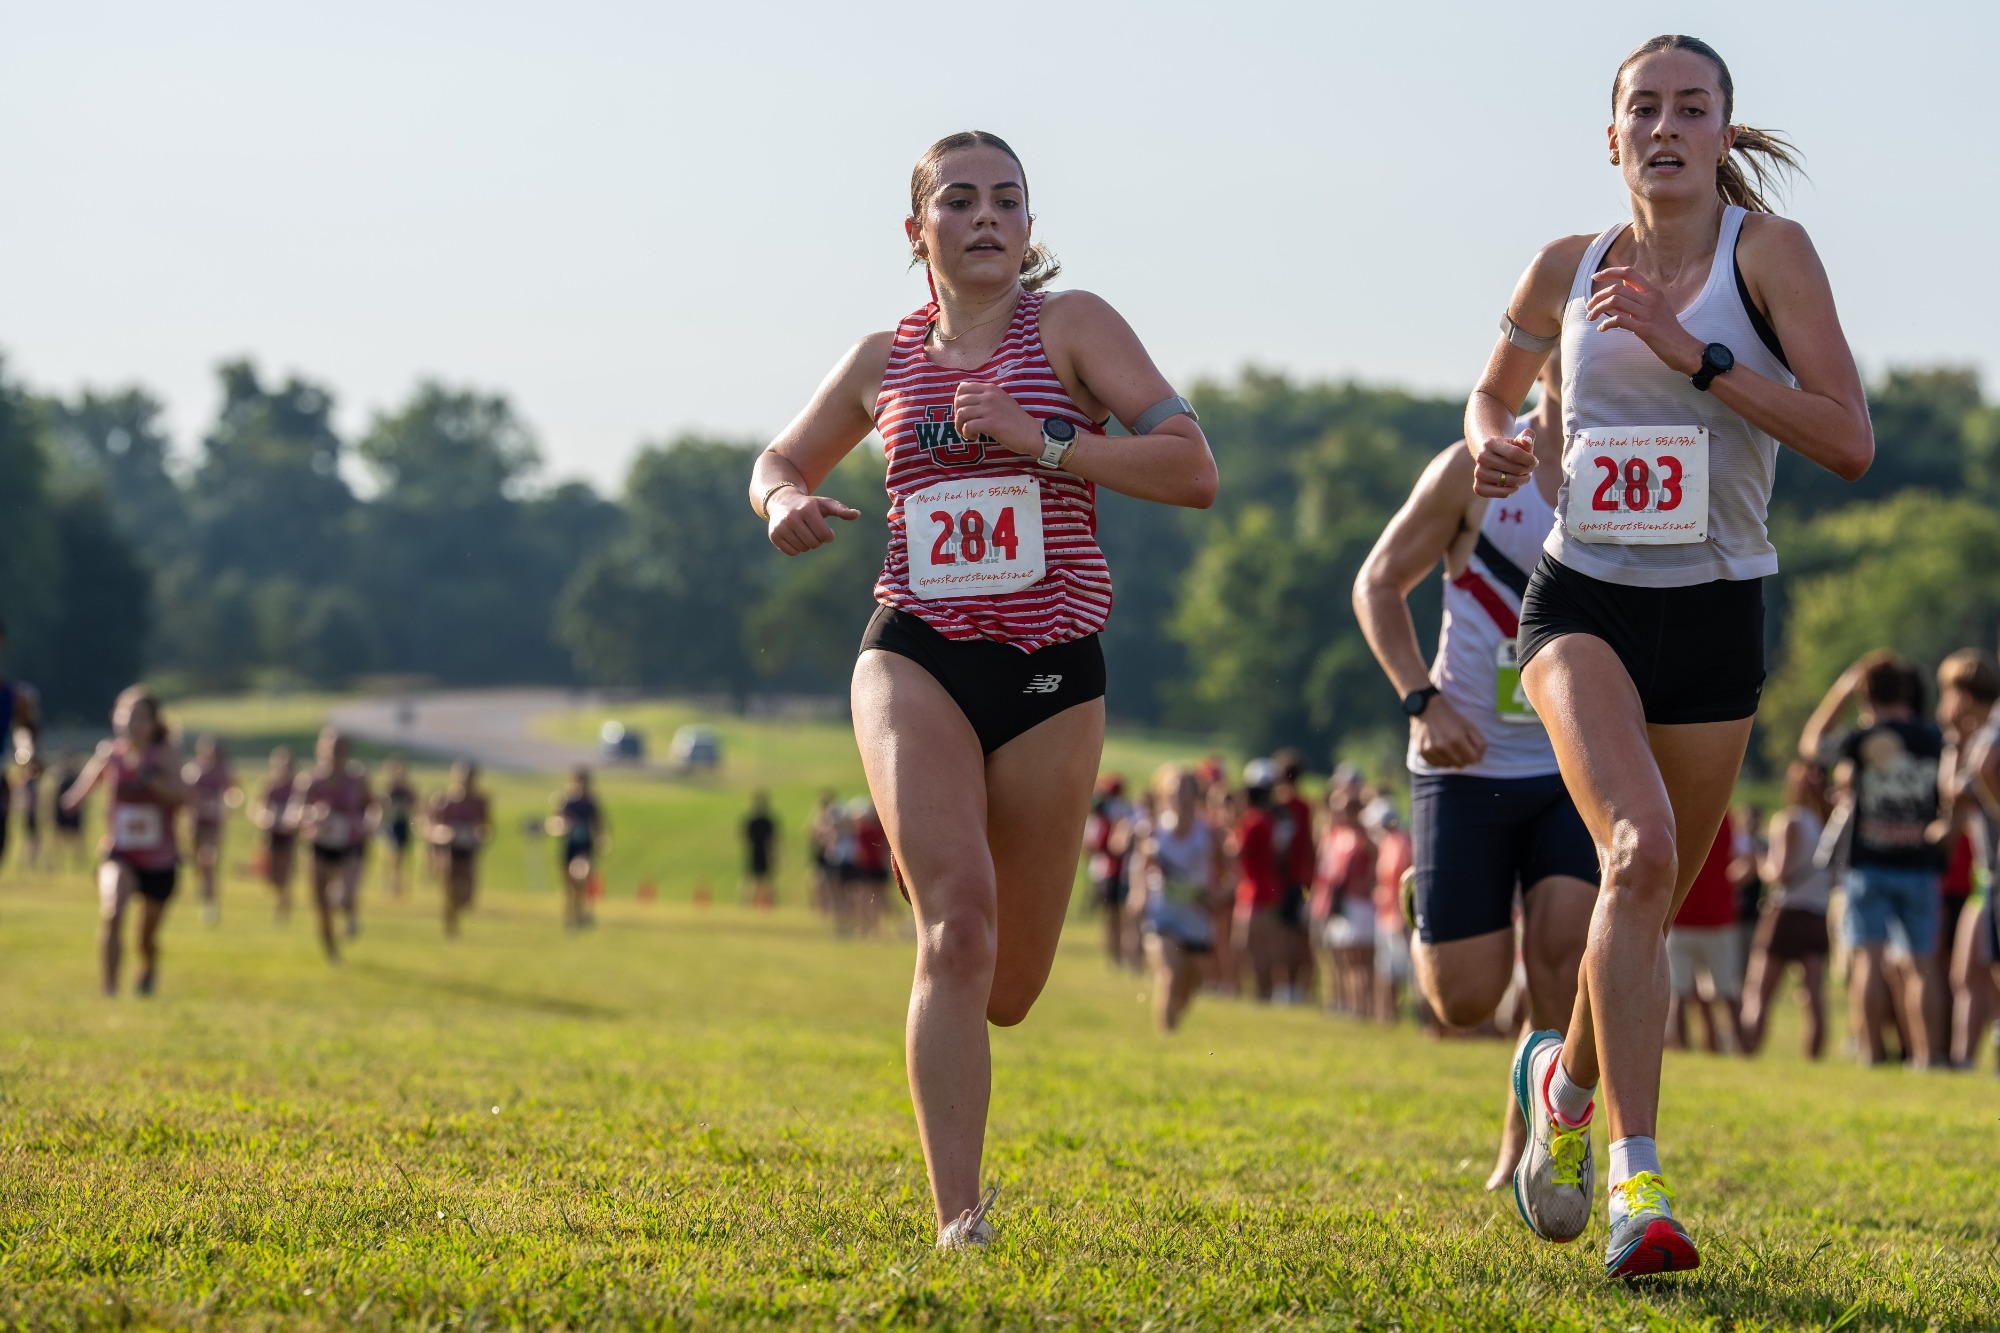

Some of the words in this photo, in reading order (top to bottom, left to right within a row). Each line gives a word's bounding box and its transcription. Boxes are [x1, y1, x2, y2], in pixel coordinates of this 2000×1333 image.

[1584, 438, 1605, 448] Moab
[1609, 437, 1628, 448] Red
[1632, 436, 1650, 446] Hot
[1592, 455, 1683, 511] 283
[917, 492, 941, 504] Moab
[944, 490, 962, 501] Red
[966, 489, 984, 499] Hot
[1578, 521, 1697, 532] GrassRootsEvents.net
[930, 506, 1019, 566] 284
[919, 569, 1034, 587] GrassRootsEvents.net
